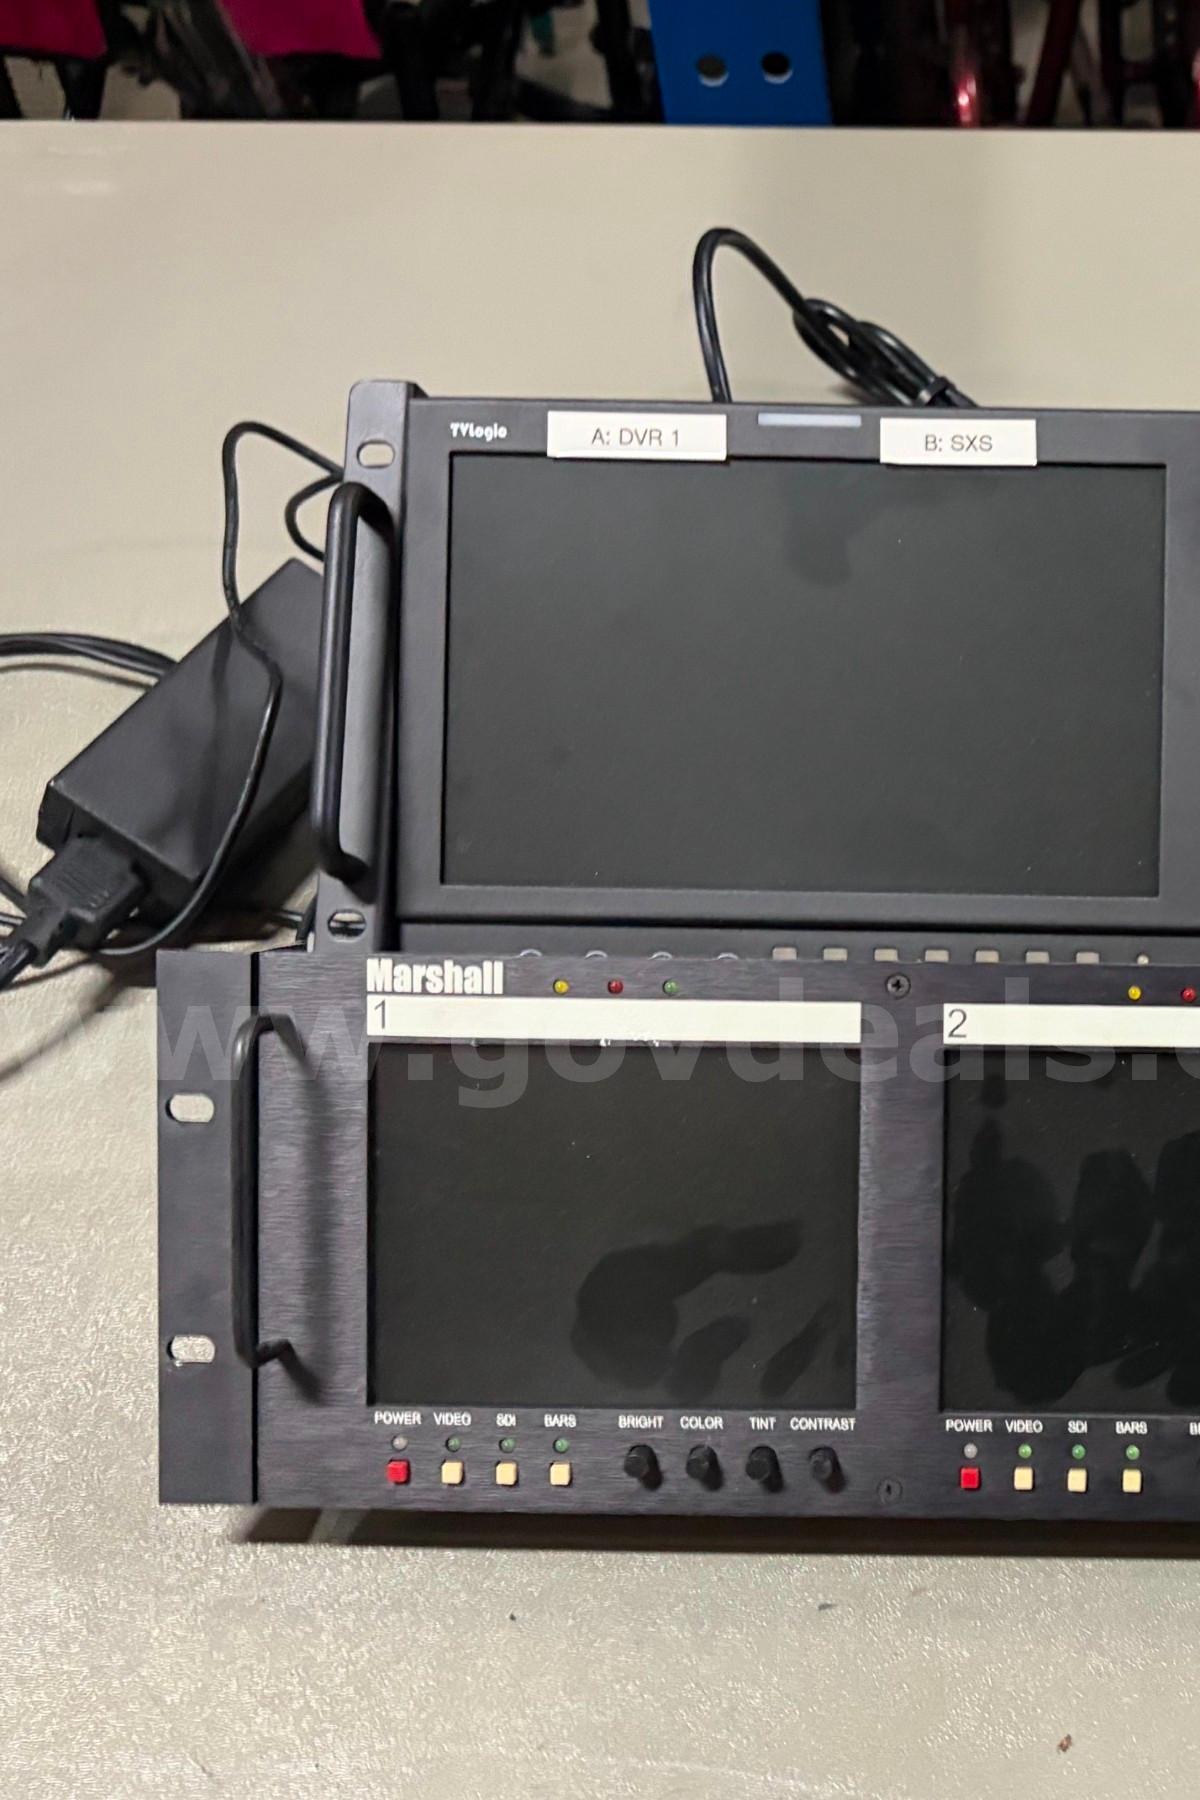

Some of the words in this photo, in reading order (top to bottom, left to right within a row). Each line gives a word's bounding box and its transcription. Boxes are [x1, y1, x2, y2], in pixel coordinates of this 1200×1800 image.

[591, 427, 611, 447] A:
[618, 427, 663, 447] DVR
[671, 428, 680, 448] 1
[924, 433, 943, 453] B:
[950, 433, 993, 453] SXS
[366, 957, 504, 995] Marshall
[374, 999, 386, 1030] 1
[948, 1008, 967, 1038] 2
[374, 1410, 422, 1426] POWER
[433, 1411, 472, 1427] VIDEO
[495, 1412, 517, 1427] SDI
[543, 1413, 577, 1428] BARS
[617, 1414, 664, 1429] BRIGHT
[679, 1415, 724, 1430] COLOR
[748, 1416, 777, 1431] TINT
[789, 1416, 856, 1432] CONTRAST
[945, 1418, 993, 1433] POWER
[1004, 1419, 1044, 1434] VIDEO
[1067, 1419, 1088, 1434] SDI
[1115, 1420, 1148, 1435] BARS
